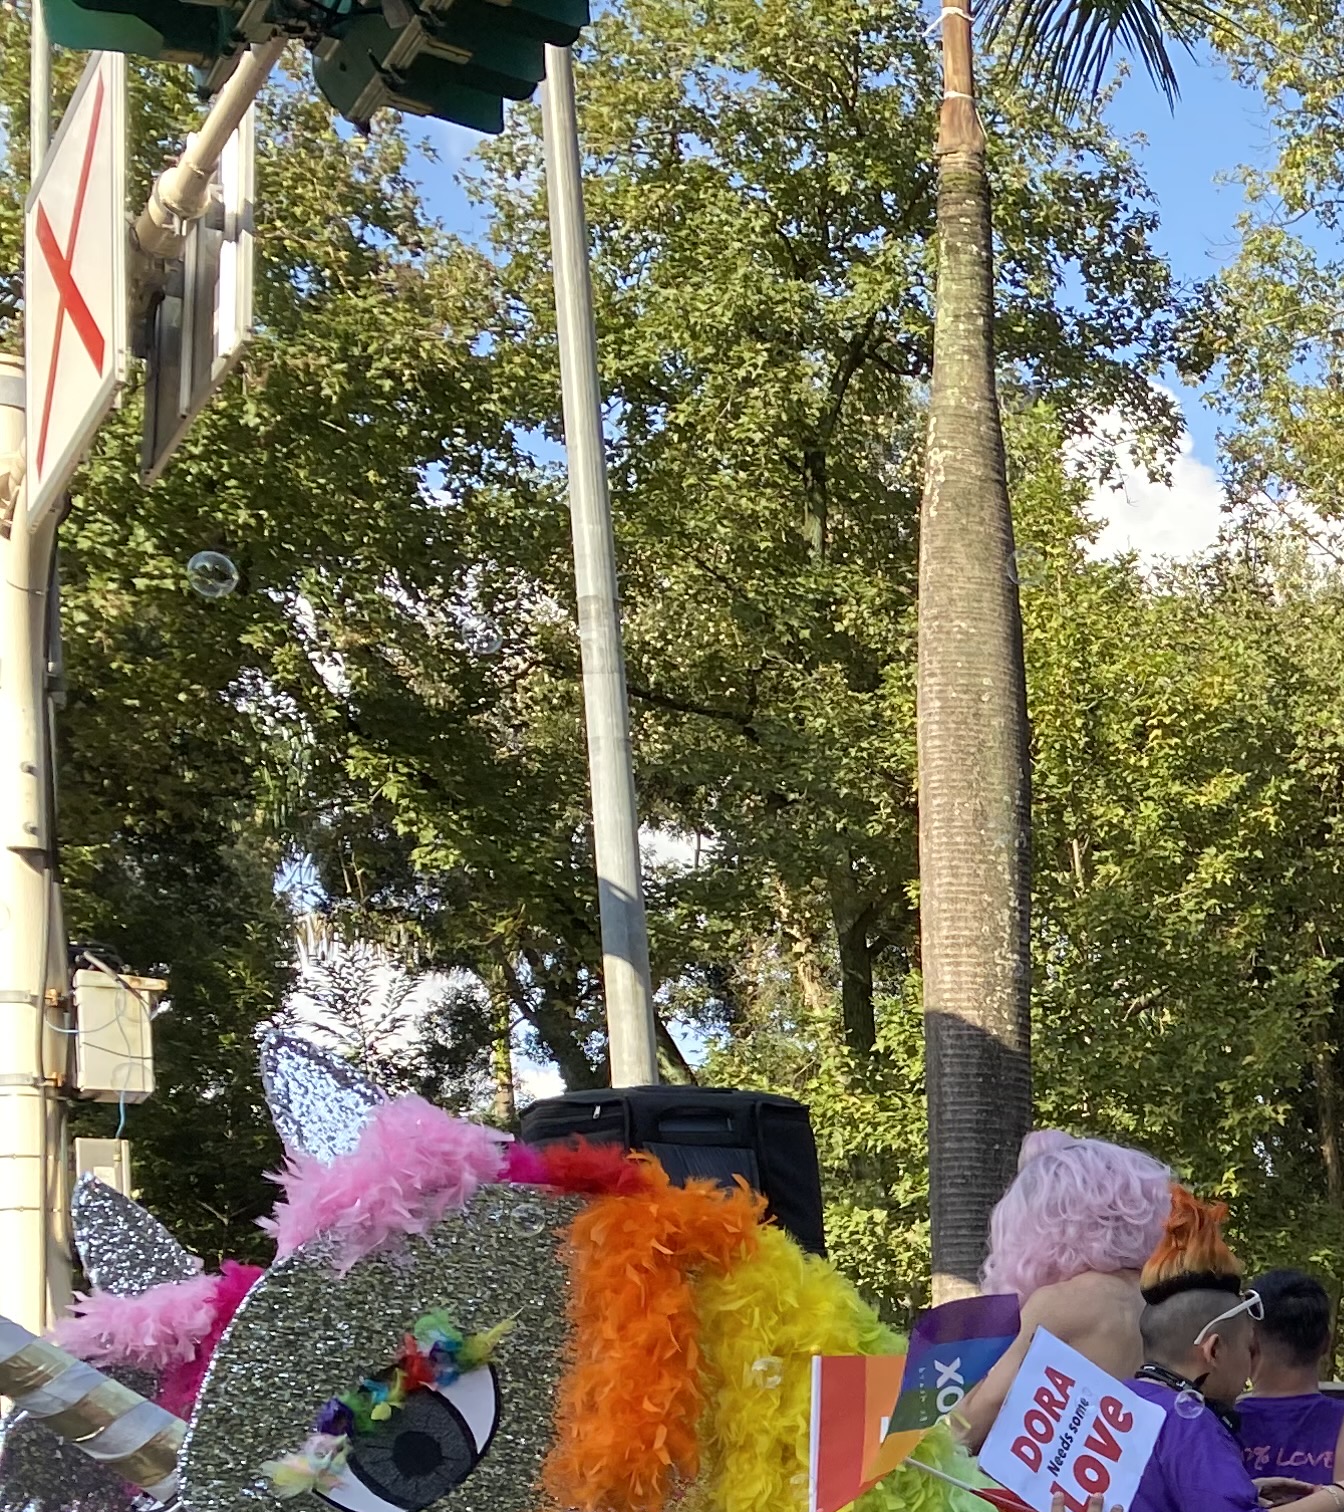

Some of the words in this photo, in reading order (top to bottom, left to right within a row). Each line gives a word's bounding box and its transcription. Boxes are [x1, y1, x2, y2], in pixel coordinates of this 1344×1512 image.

[1010, 1365, 1076, 1474] DORA
[1046, 1433, 1074, 1478] Needs
[1068, 1397, 1090, 1435] some
[1276, 1447, 1335, 1469] LOVE
